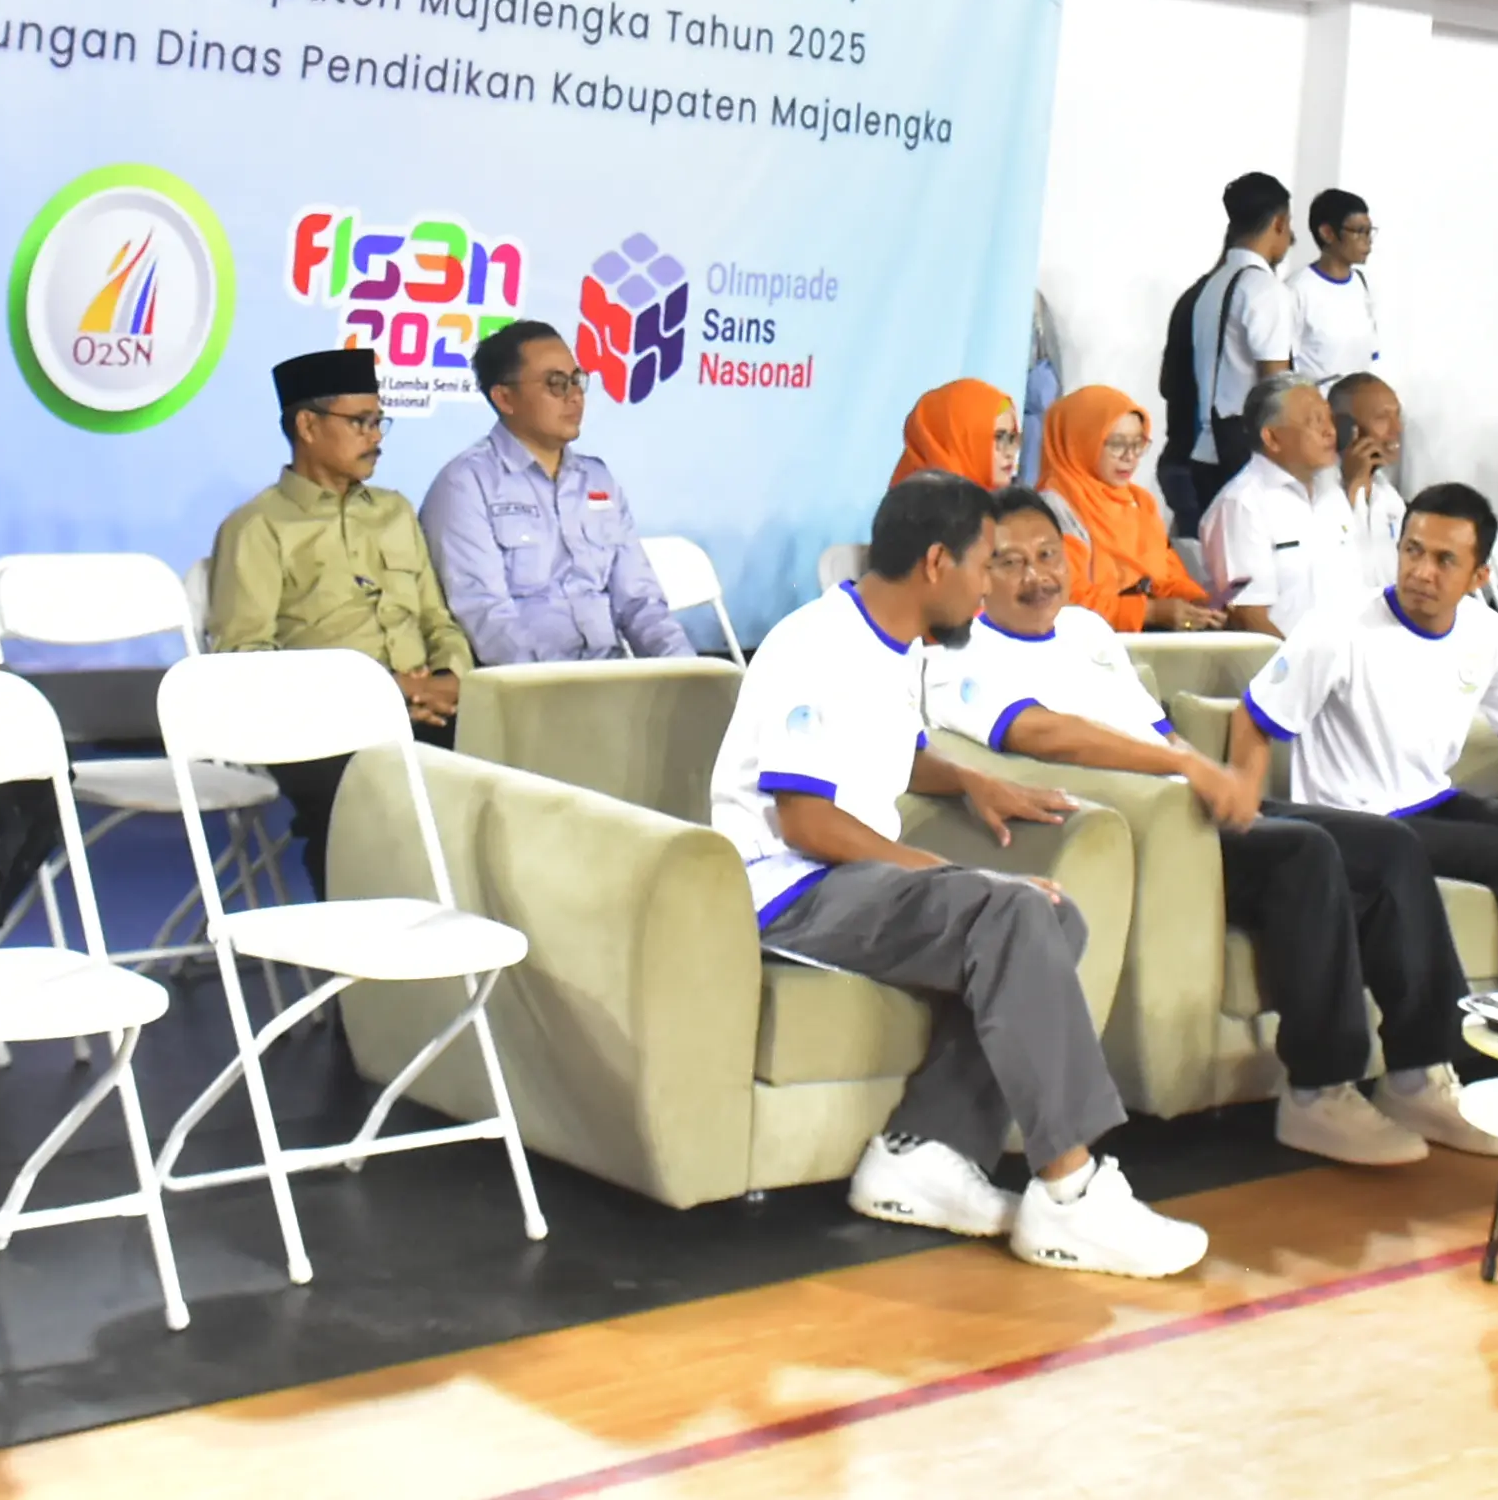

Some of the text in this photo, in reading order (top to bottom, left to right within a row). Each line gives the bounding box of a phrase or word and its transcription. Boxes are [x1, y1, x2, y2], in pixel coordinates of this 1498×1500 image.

[666, 10, 774, 55] Tahun
[788, 25, 866, 65] 2025
[156, 28, 282, 77] Dinas
[301, 45, 536, 102] Pendidikan
[551, 71, 758, 125] Kabupaten
[771, 94, 953, 150] Majalengka
[707, 262, 838, 307] Olimpiade
[702, 308, 776, 344] Sains
[73, 336, 153, 367] O2SN
[388, 376, 429, 391] Lomba
[432, 378, 459, 392] Seni
[699, 352, 813, 388] Nasional
